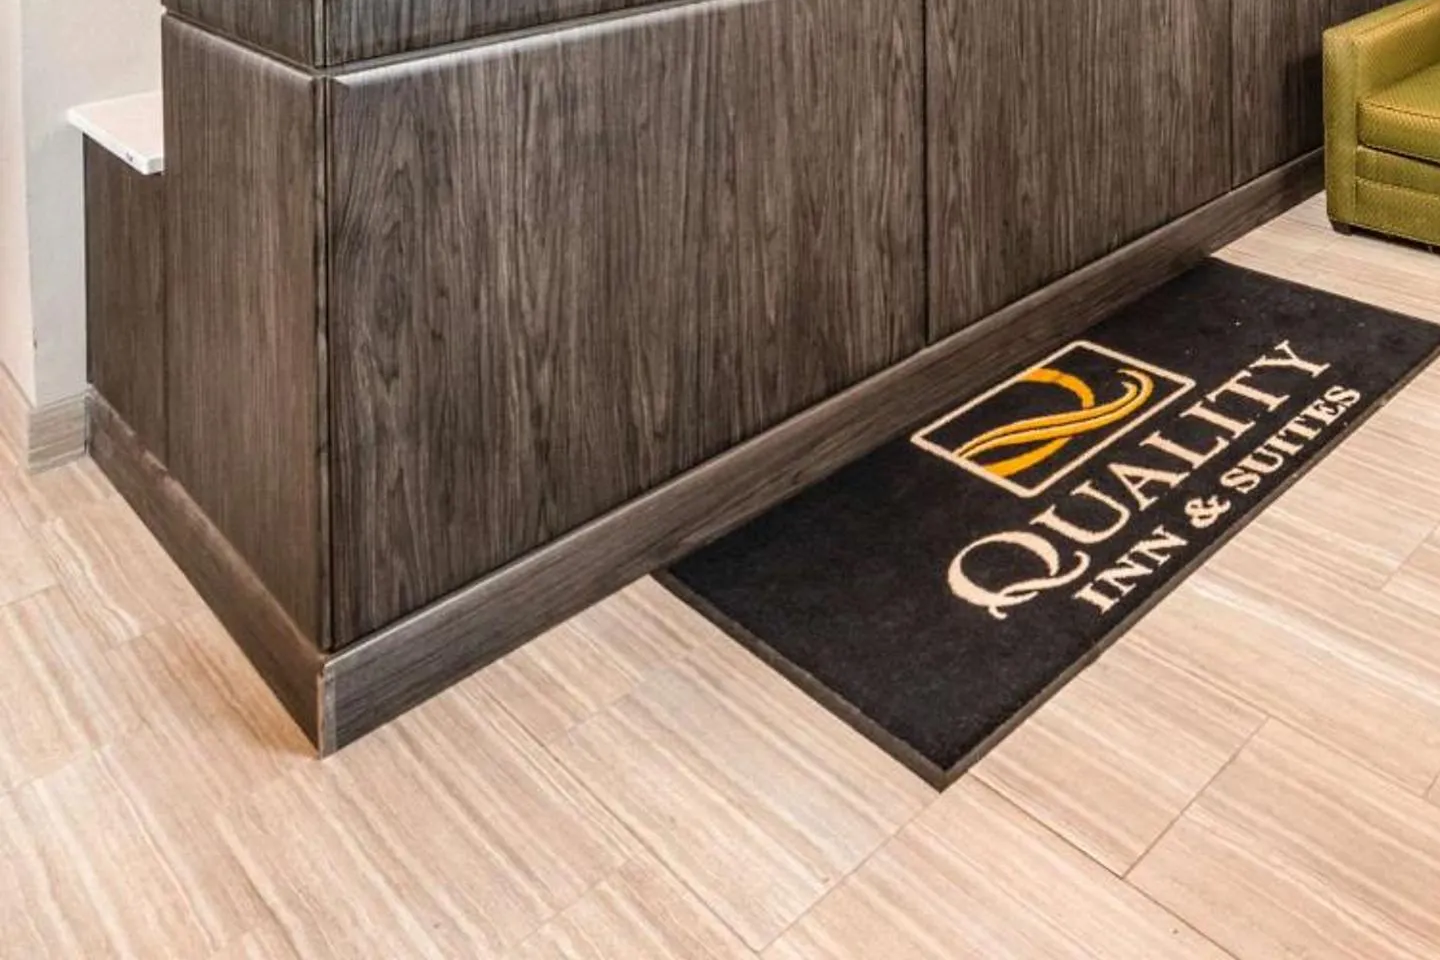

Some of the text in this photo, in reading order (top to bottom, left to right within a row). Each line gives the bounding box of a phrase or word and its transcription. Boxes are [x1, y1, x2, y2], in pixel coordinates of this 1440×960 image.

[948, 339, 1331, 620] QUALITY
[1072, 386, 1361, 614] INN & SUITES
